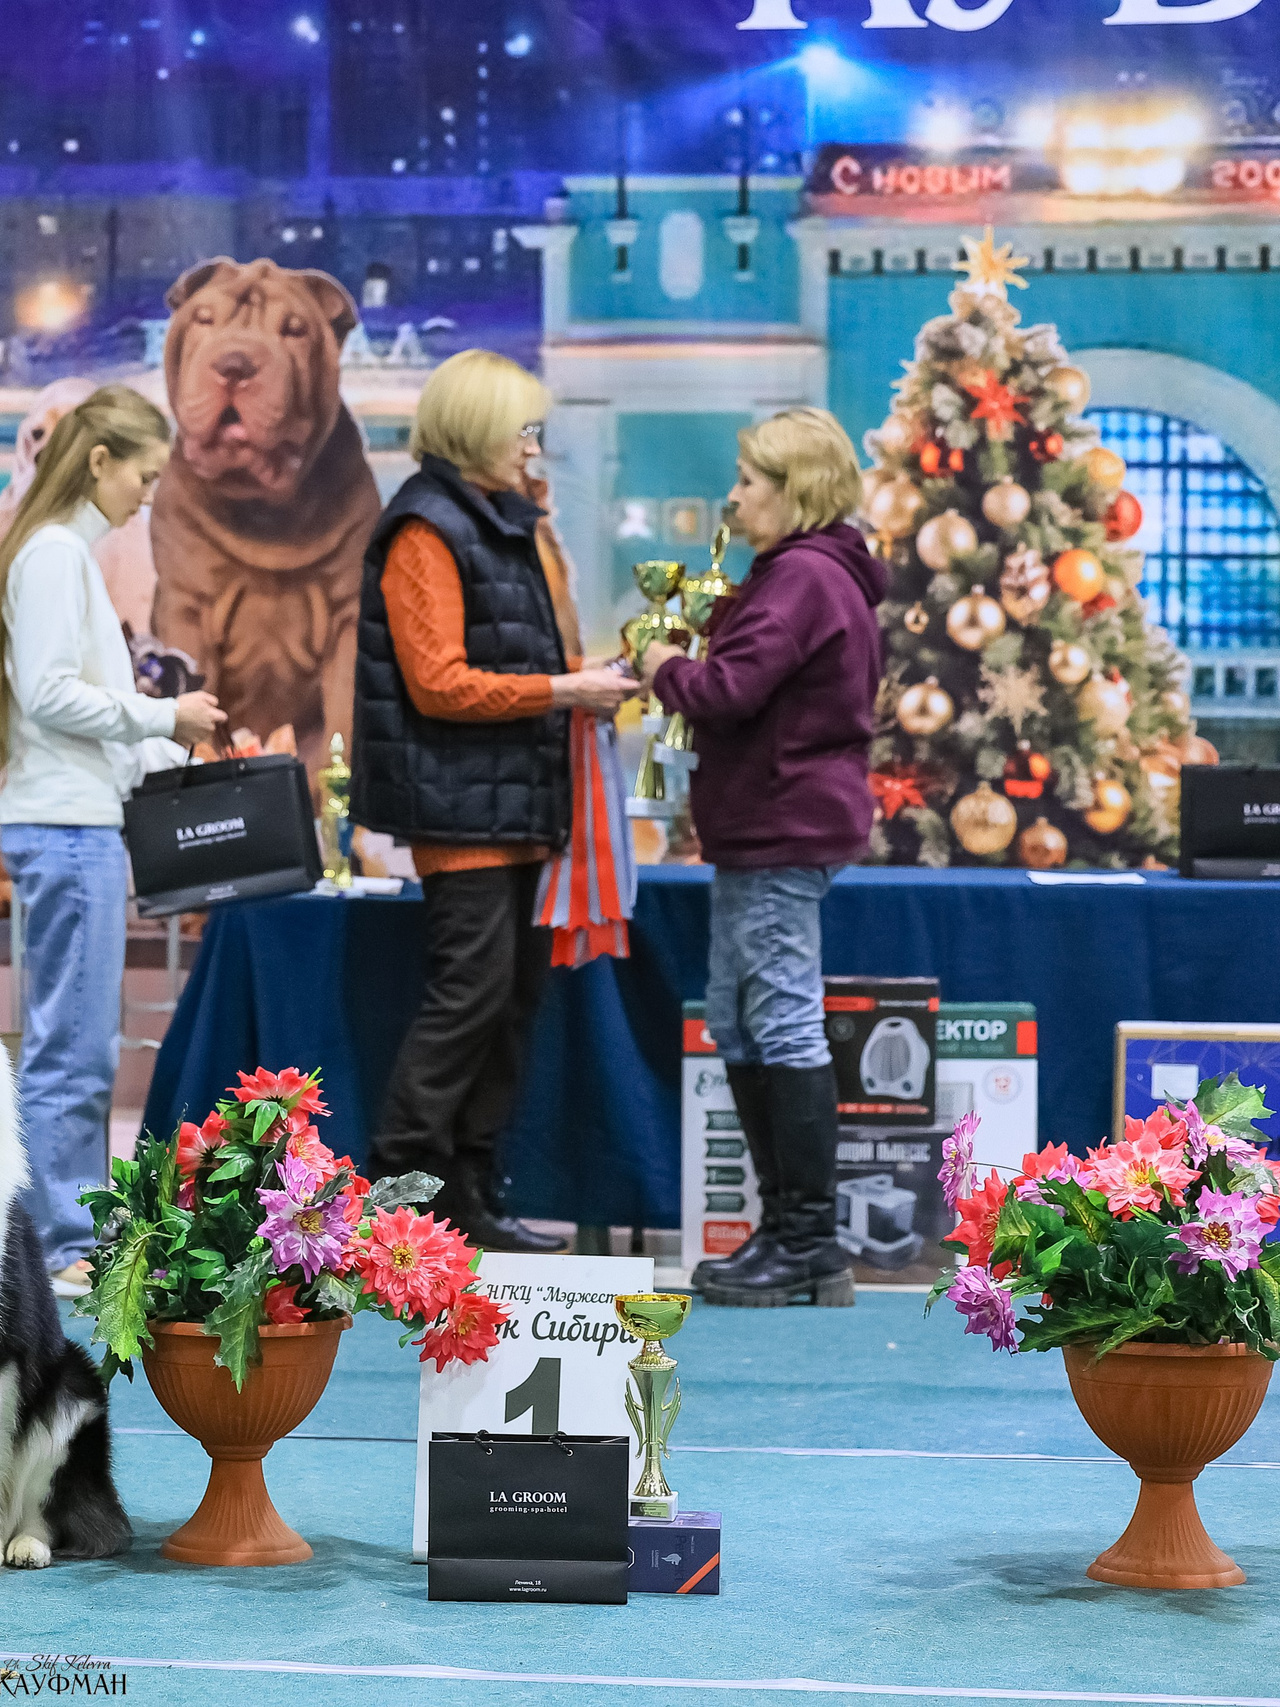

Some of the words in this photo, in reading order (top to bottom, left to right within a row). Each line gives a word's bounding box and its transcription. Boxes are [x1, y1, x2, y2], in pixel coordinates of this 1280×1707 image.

[831, 155, 862, 195] С
[937, 1019, 1008, 1041] ЕКТОР
[487, 1284, 533, 1304] НГКЦ
[505, 1357, 561, 1434] 1
[489, 1491, 508, 1503] LA
[512, 1491, 567, 1503] GROOM
